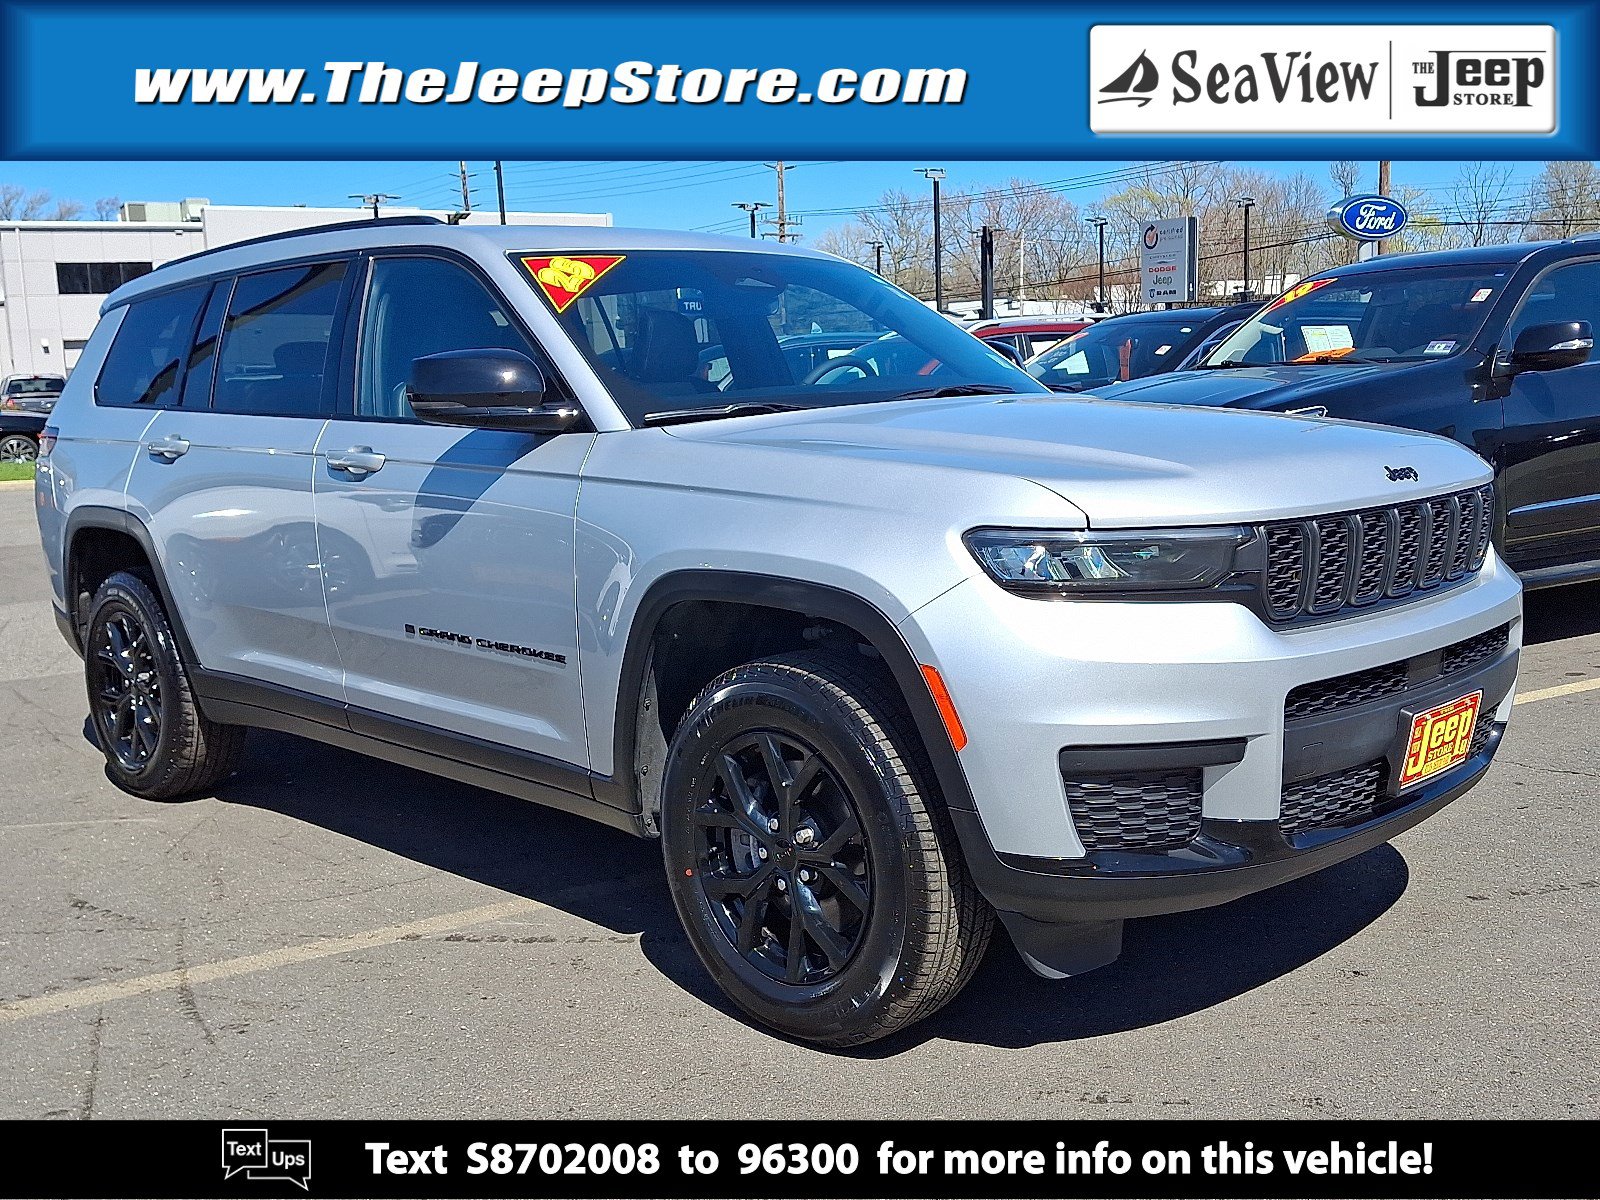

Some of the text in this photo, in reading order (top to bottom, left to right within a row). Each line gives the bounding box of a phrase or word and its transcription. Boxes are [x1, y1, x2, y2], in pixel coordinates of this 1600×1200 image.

[1355, 203, 1396, 230] Ford
[1148, 265, 1177, 273] DODGE
[1152, 275, 1172, 286] Jeep
[1383, 465, 1419, 482] Jeep
[418, 626, 472, 645] GRAND
[475, 637, 567, 665] CHEROKEE
[1406, 707, 1474, 777] Jeep
[1427, 742, 1455, 761] STORE
